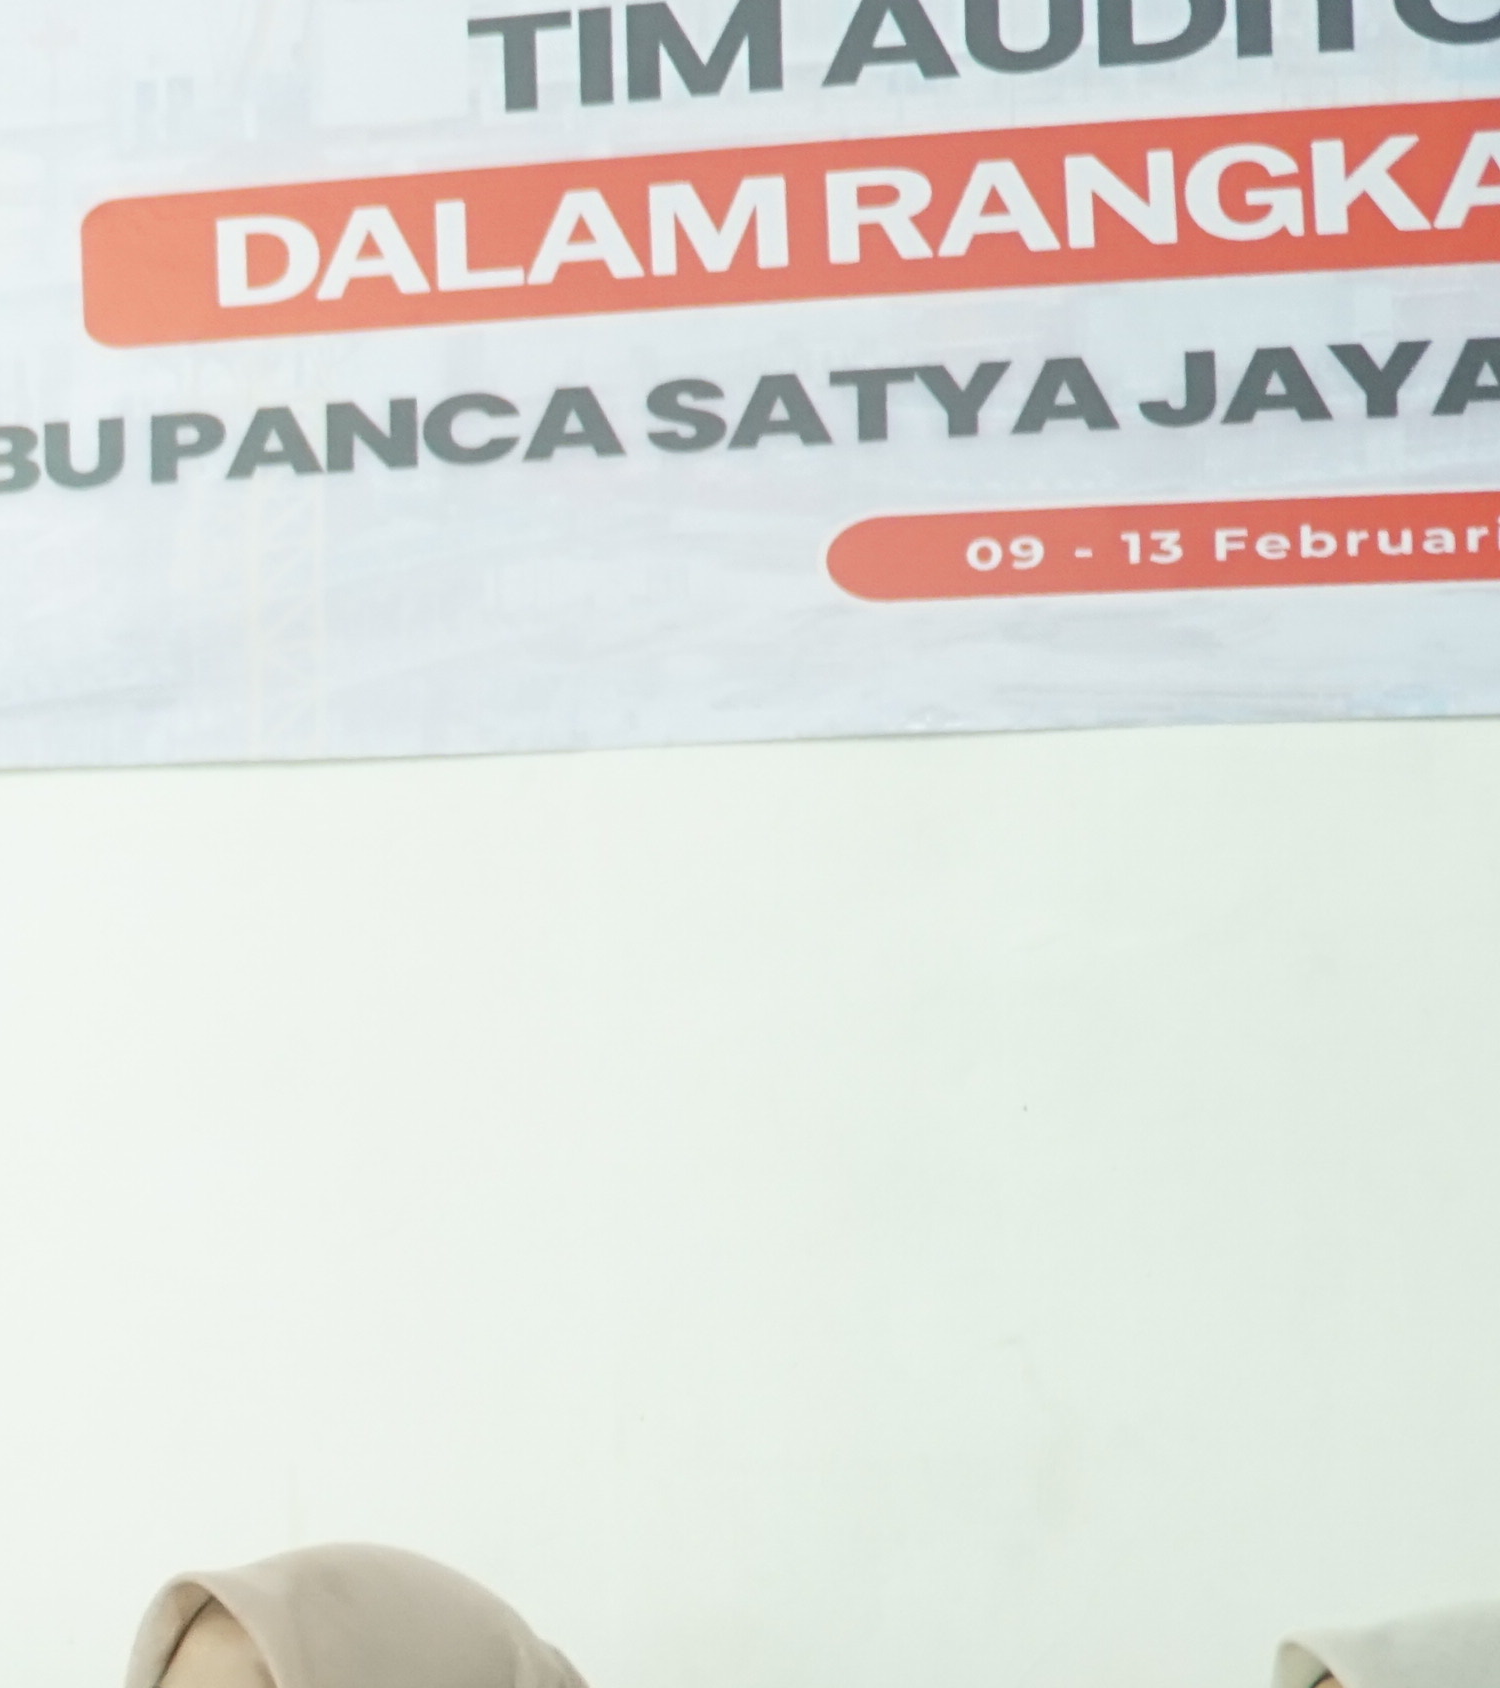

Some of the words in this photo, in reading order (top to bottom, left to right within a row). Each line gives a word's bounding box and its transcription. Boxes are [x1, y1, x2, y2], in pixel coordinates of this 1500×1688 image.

[467, 0, 783, 113] TIM
[216, 176, 789, 310] DALAM
[824, 129, 1500, 265] RANGKA
[150, 386, 626, 484] PANCA
[645, 357, 1120, 454] SATYA
[1139, 337, 1500, 428] JAYA
[966, 536, 1045, 572] 09
[1120, 530, 1184, 565] 13
[1216, 514, 1500, 563] Februar
